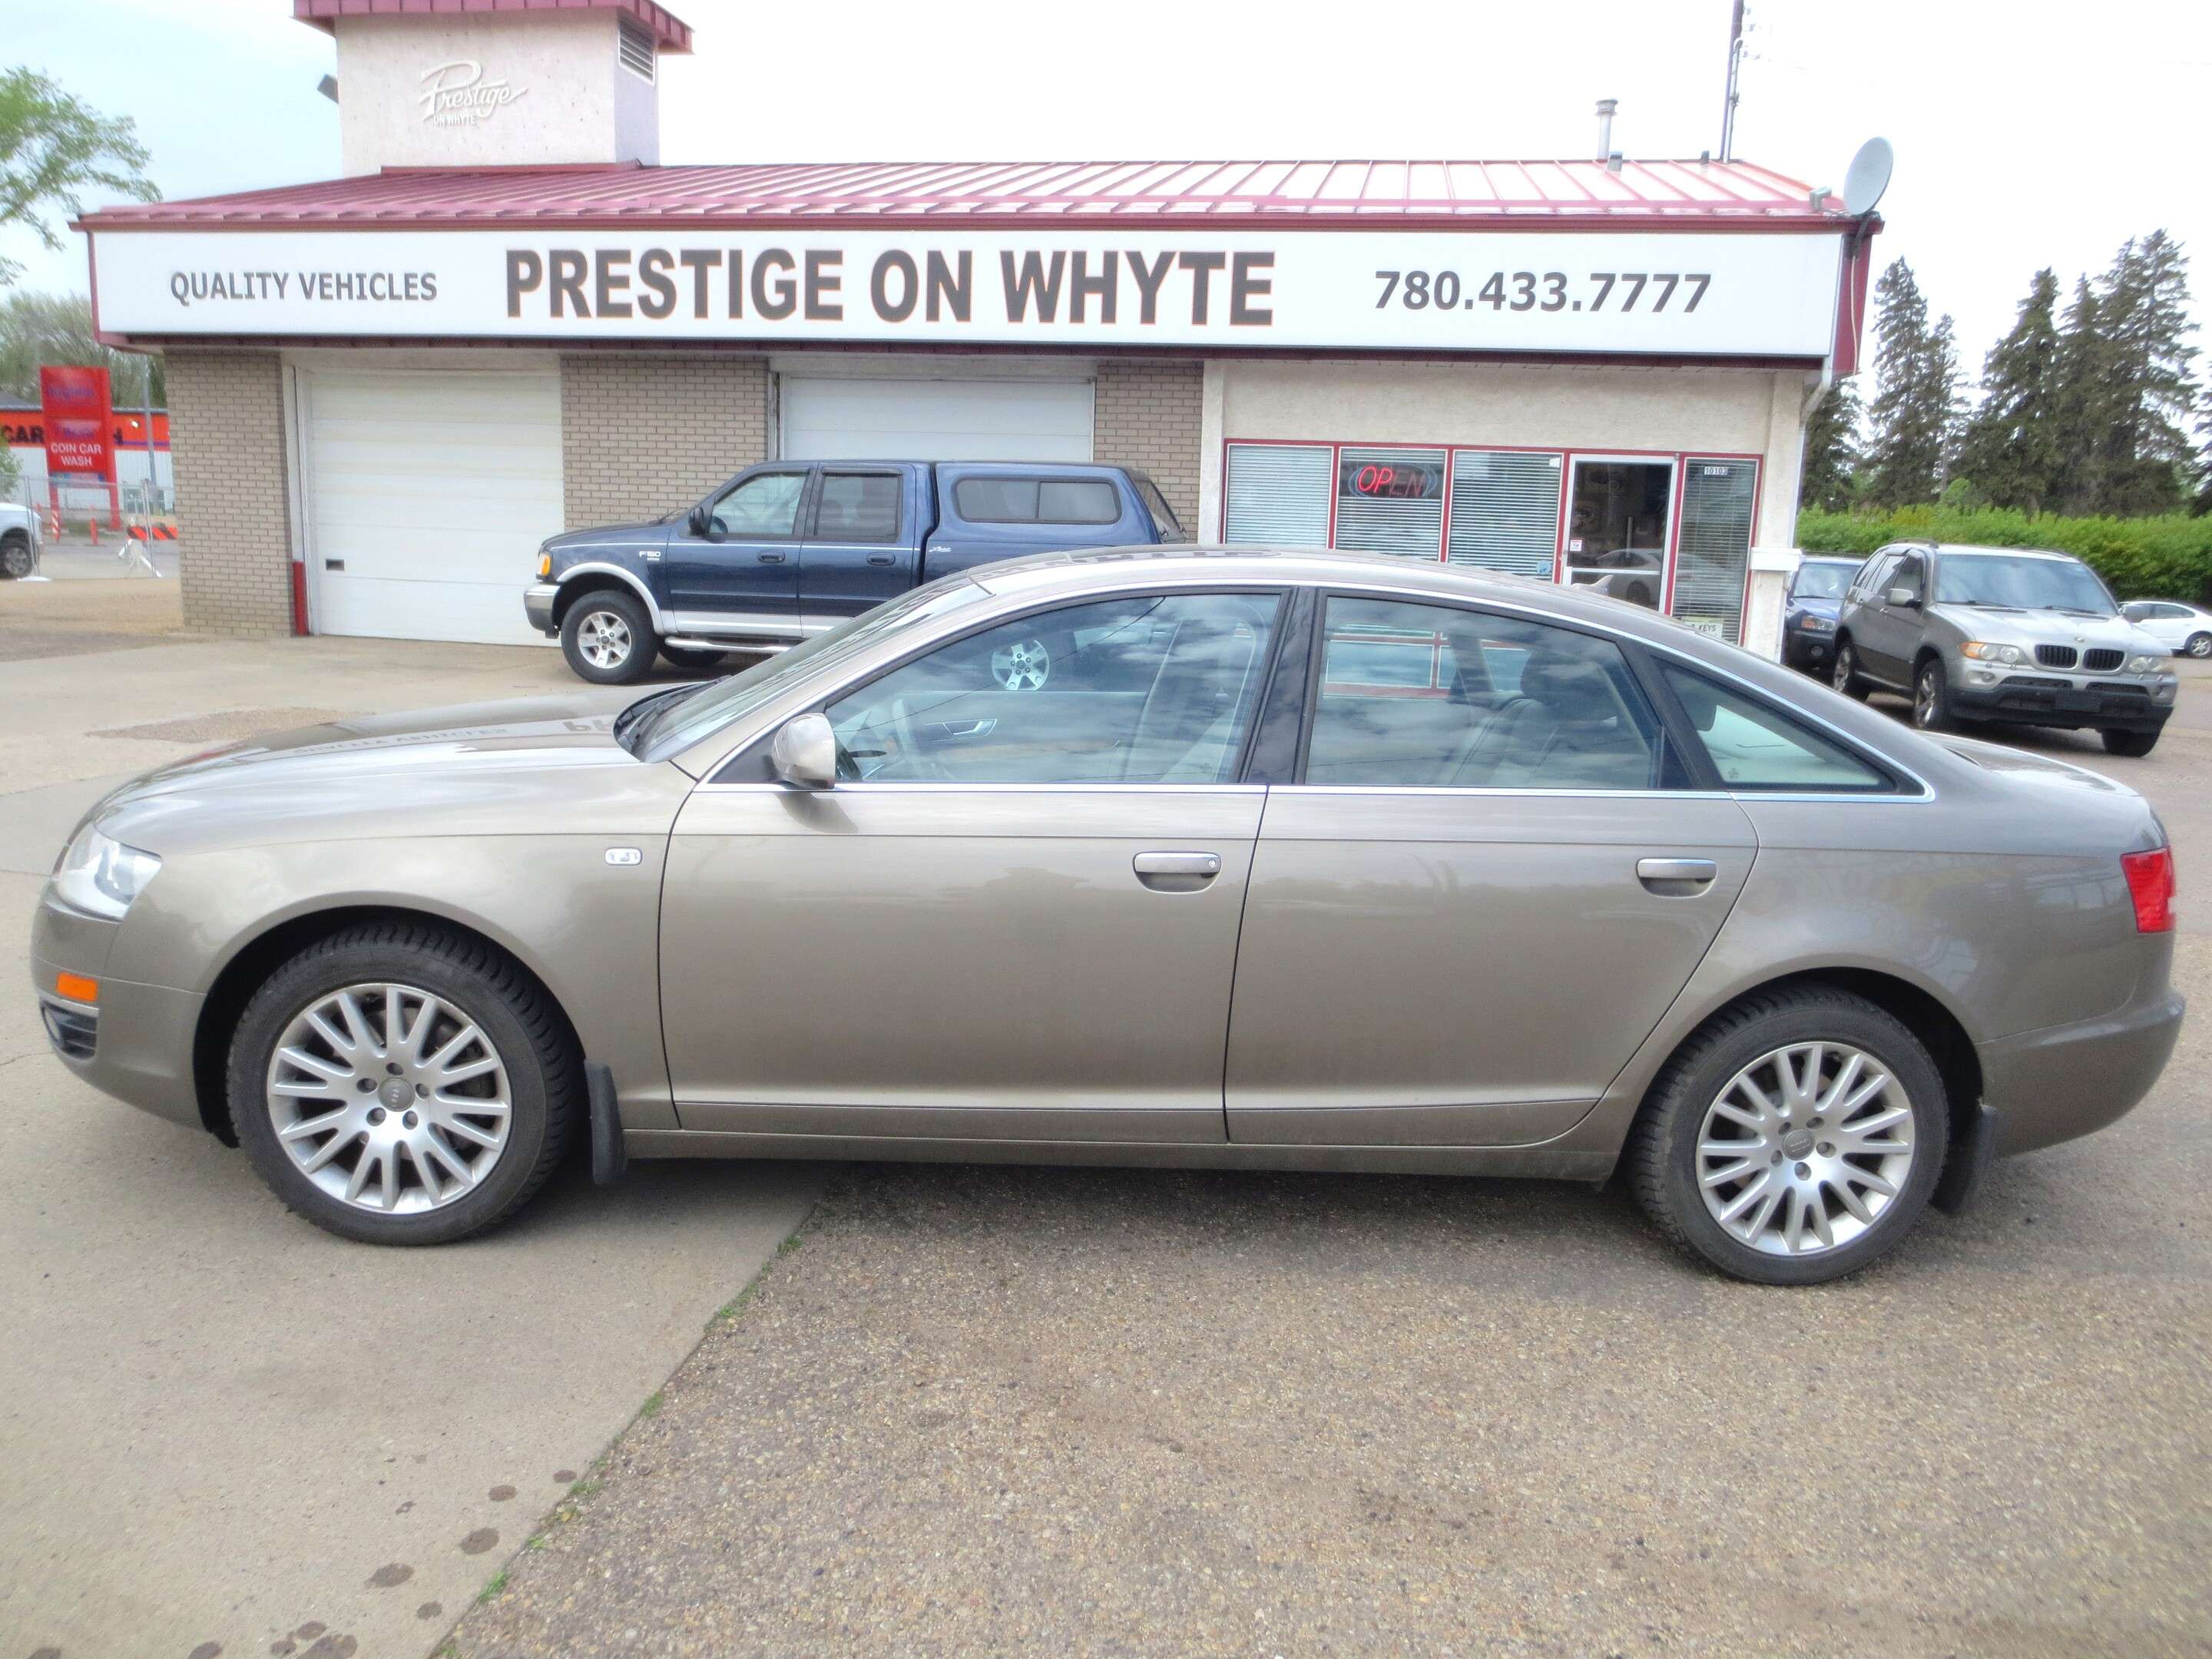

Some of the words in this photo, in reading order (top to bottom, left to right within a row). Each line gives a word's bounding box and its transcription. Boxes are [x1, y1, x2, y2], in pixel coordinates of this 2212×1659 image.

[419, 60, 529, 121] Prestige
[433, 114, 445, 126] ON
[446, 113, 477, 125] WHYTE
[171, 271, 289, 306] QUALITY
[299, 271, 438, 301] VEHICLES
[505, 249, 843, 320] PRESTIGE
[870, 250, 972, 323] ON
[1000, 250, 1275, 326] WHYTE
[1375, 270, 1712, 313] 780.433.7777
[51, 442, 77, 454] COIN
[79, 443, 101, 455] CAR
[61, 455, 92, 467] WASH
[1358, 465, 1427, 498] OPEN
